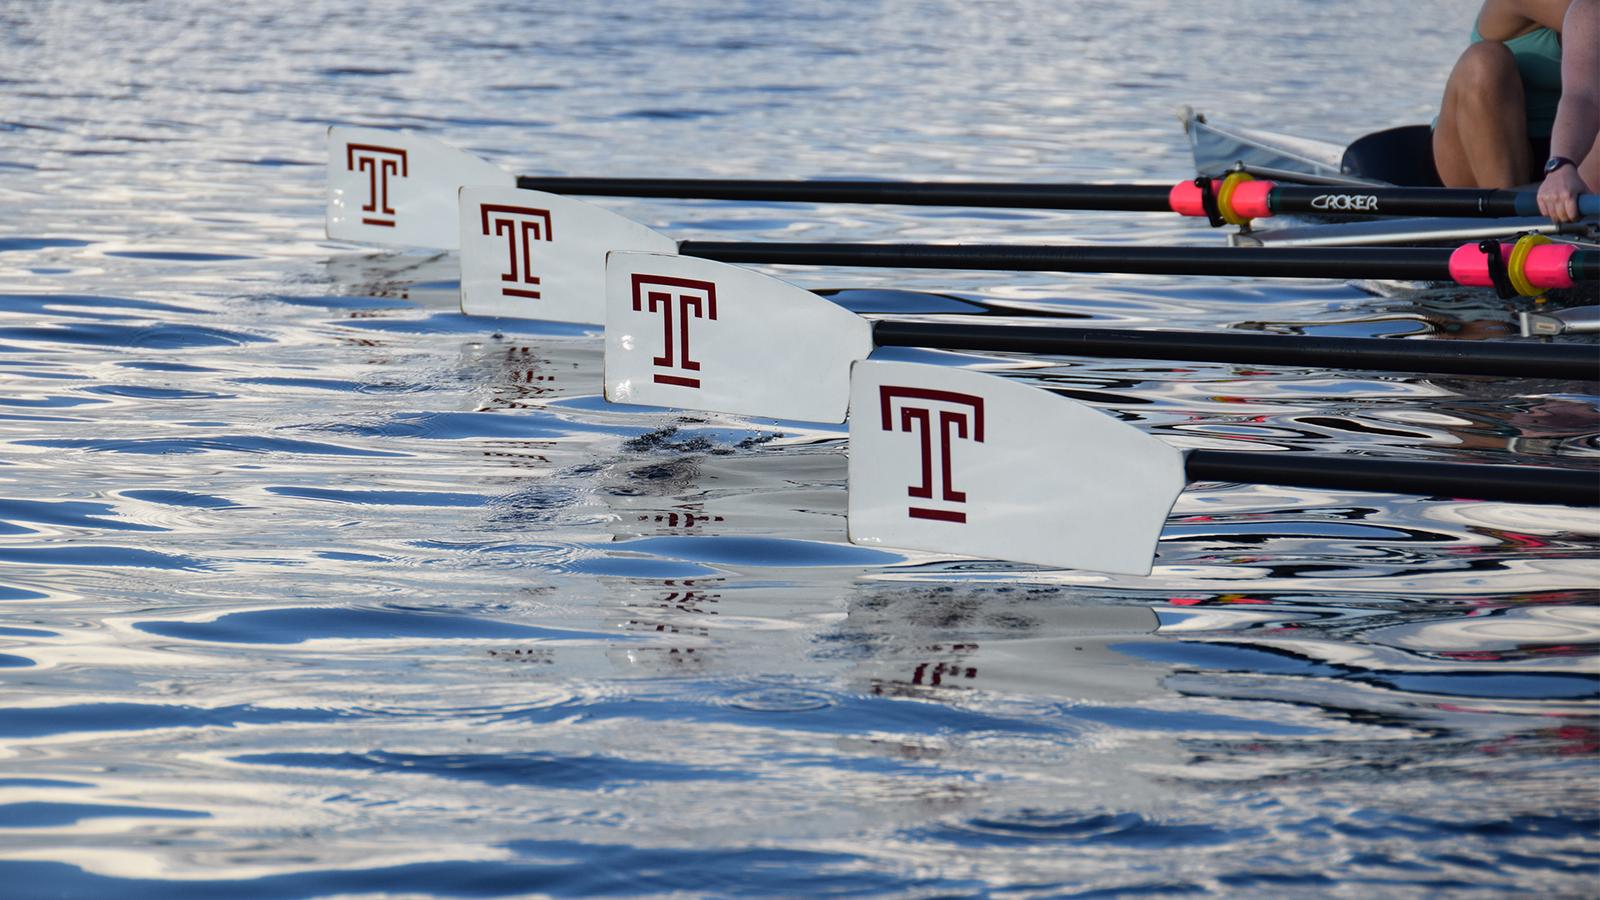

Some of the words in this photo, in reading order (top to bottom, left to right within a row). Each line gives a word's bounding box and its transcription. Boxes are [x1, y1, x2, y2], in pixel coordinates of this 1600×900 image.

[346, 142, 408, 227] T
[1310, 194, 1379, 210] CROKER
[479, 203, 552, 300] T
[630, 273, 717, 389] T
[878, 384, 985, 524] T
